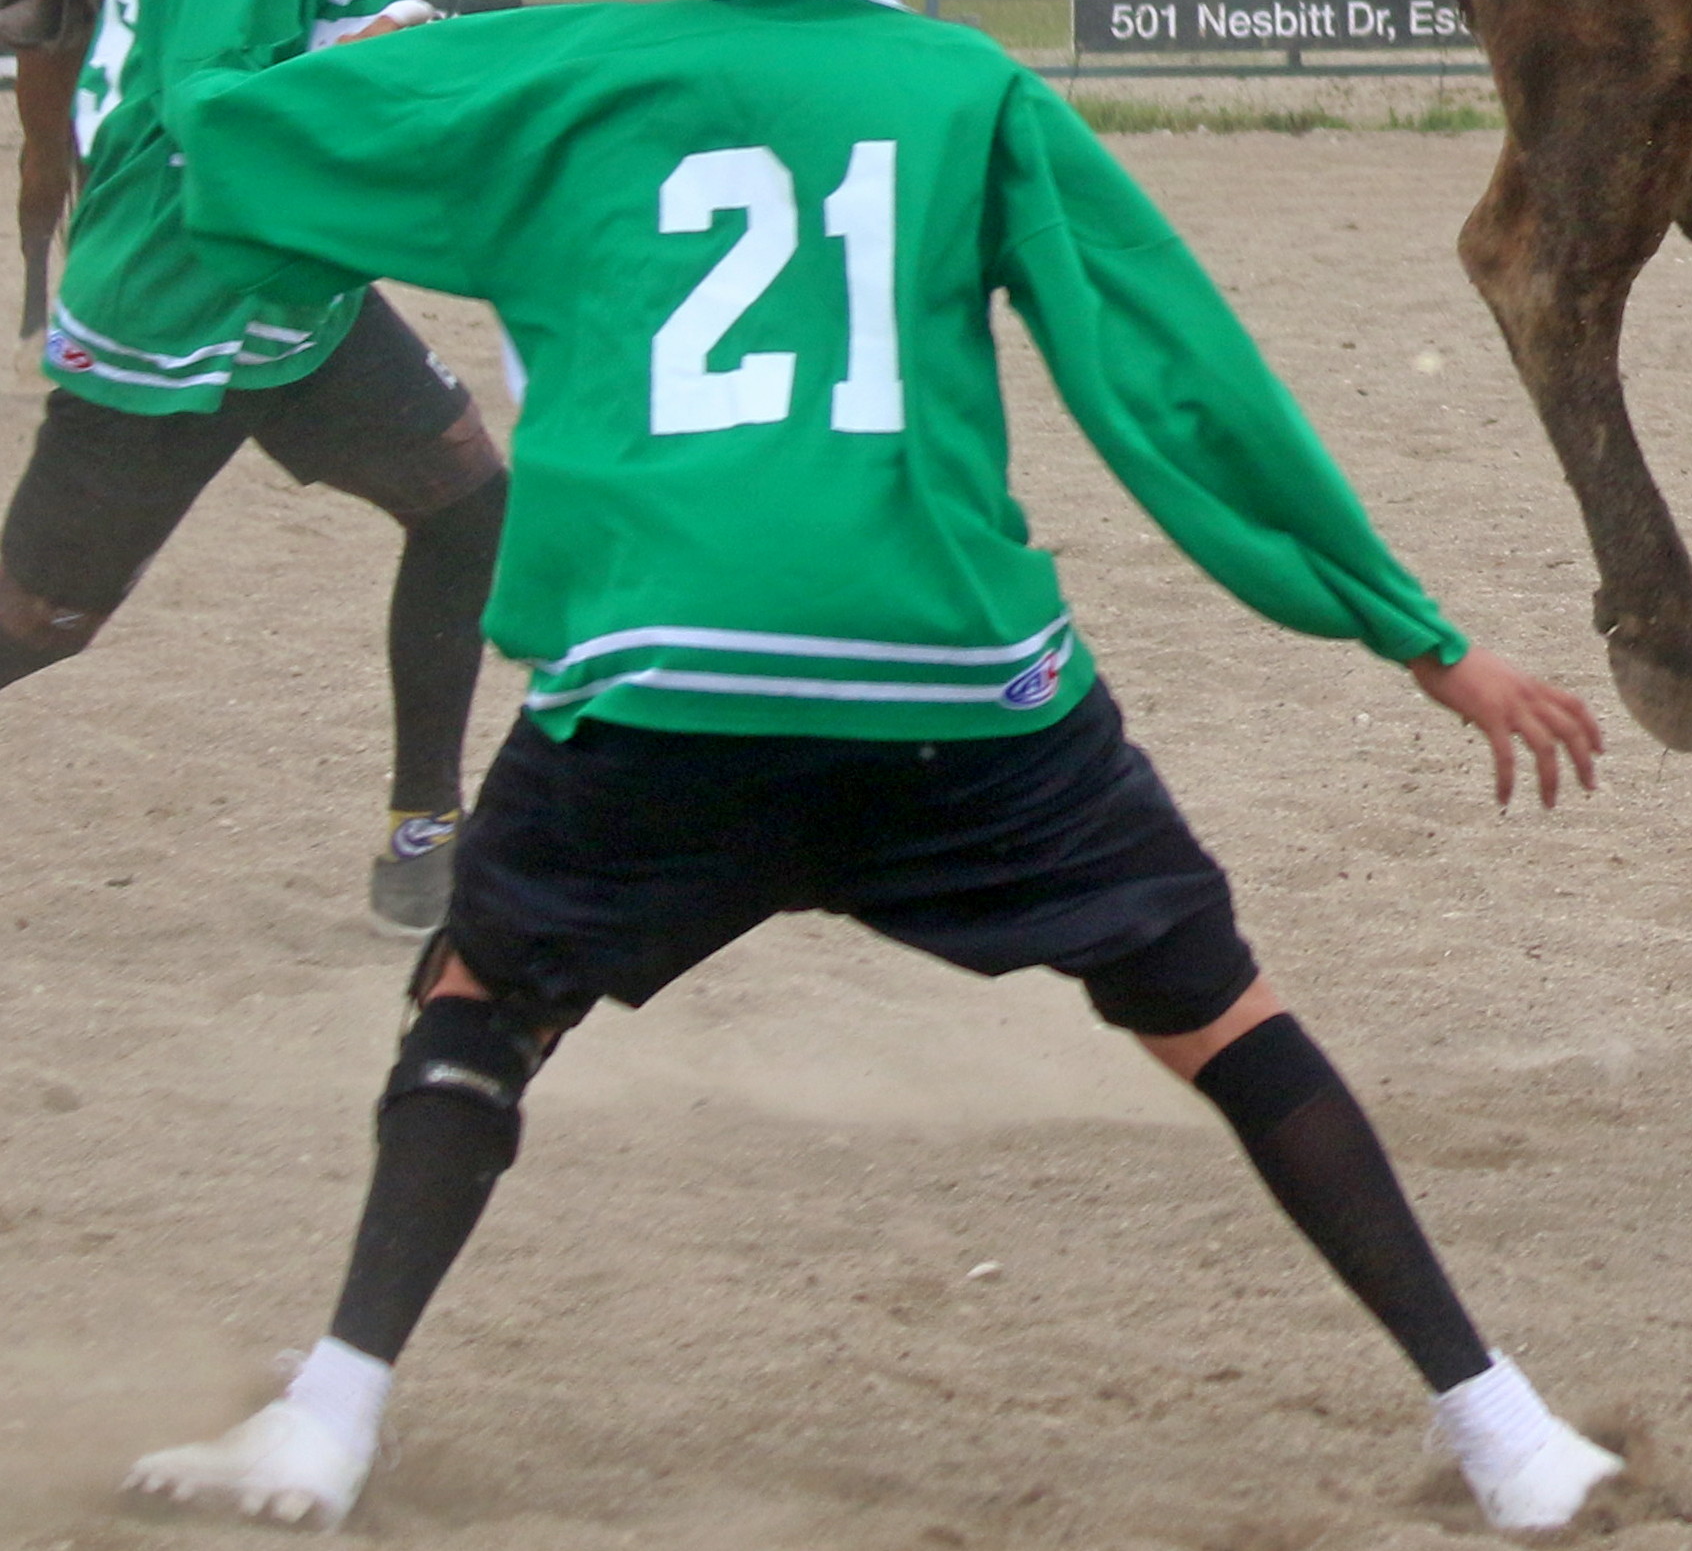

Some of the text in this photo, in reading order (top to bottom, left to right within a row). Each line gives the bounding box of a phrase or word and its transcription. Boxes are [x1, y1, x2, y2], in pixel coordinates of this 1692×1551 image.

[1110, 2, 1177, 39] 501
[1198, 0, 1336, 38] Nesbitt
[1348, 0, 1397, 41] Dr,
[650, 139, 906, 435] 21
